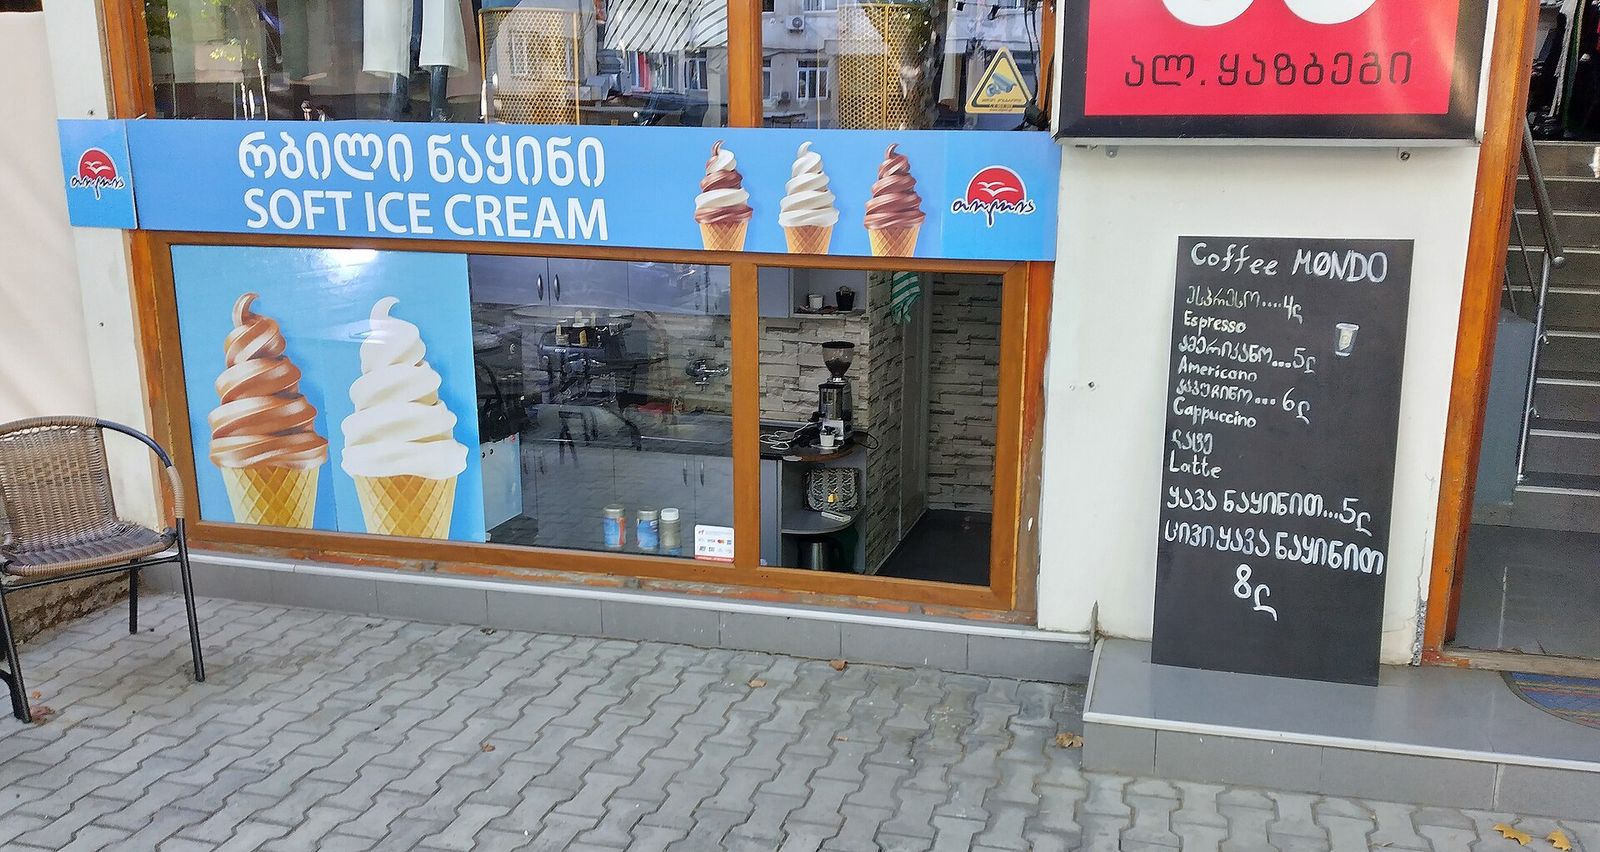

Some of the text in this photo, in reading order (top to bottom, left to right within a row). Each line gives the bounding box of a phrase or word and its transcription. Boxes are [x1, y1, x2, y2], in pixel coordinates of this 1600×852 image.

[238, 131, 605, 188] რბილი ნაყინი
[243, 188, 609, 241] SOFT ICE CREAM
[1191, 242, 1278, 275] Coffee
[1184, 310, 1248, 336] Espresso
[1177, 354, 1258, 383] Americano
[1172, 396, 1257, 428] Cappuccino
[1169, 450, 1222, 479] Latte
[1167, 485, 1217, 511] ყავა
[1275, 531, 1385, 576] ნაყინით
